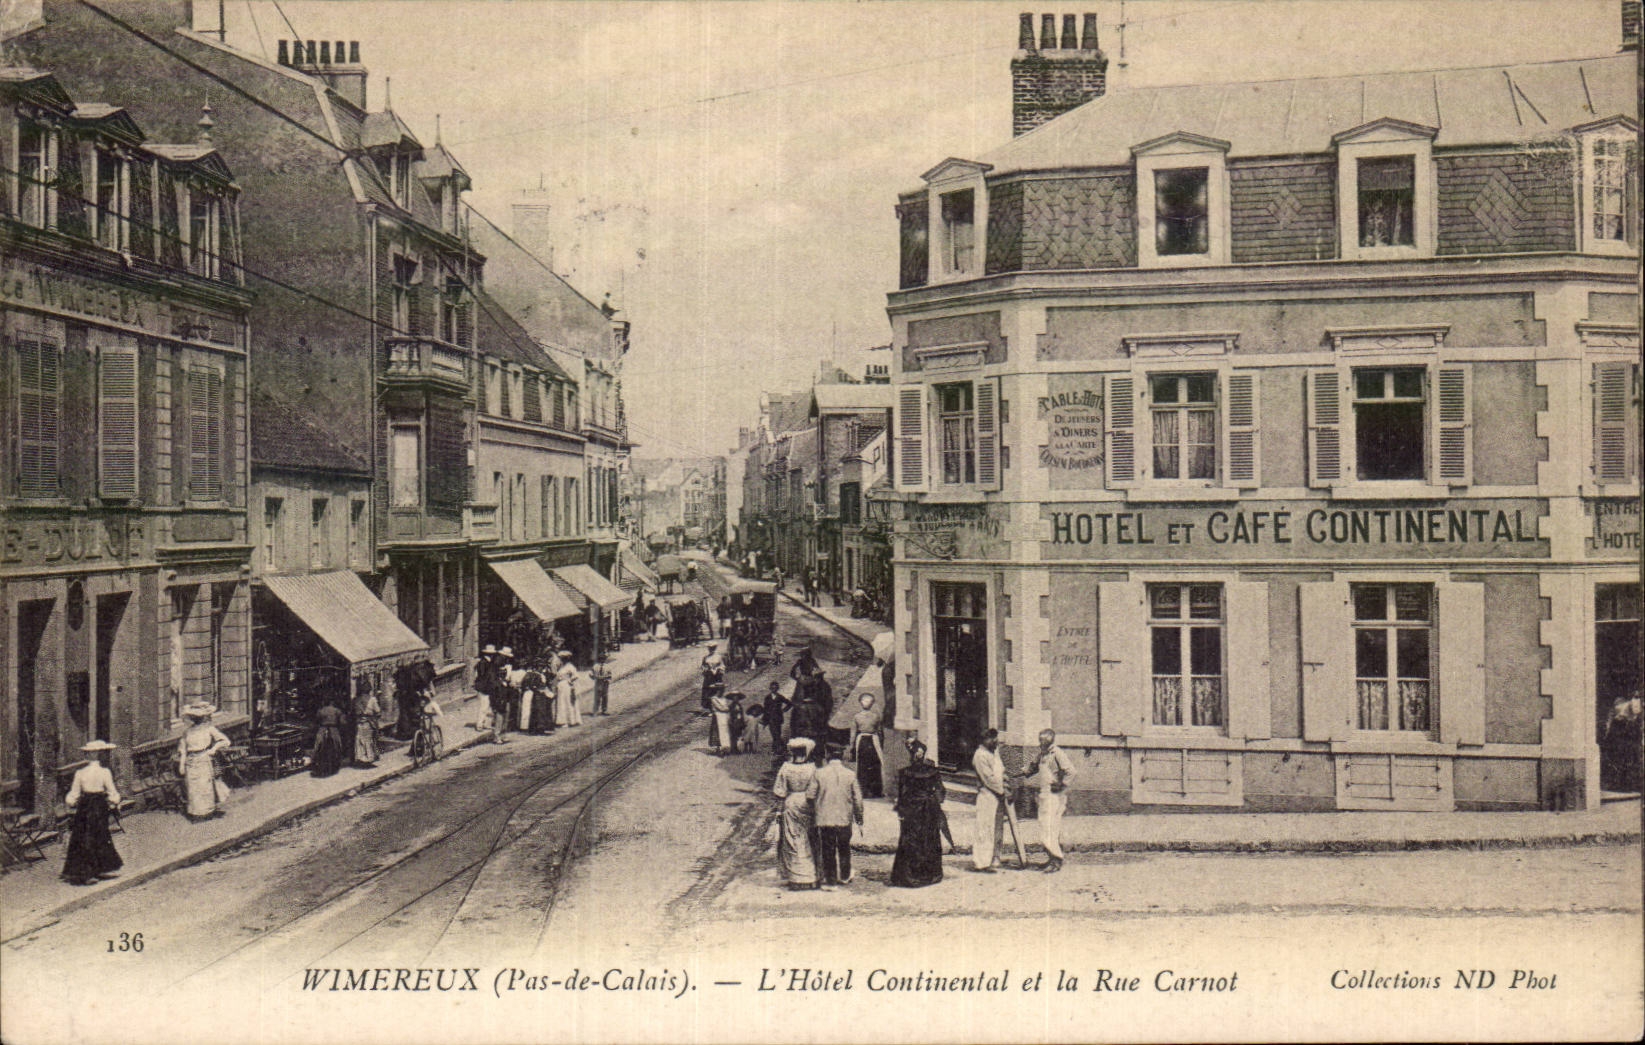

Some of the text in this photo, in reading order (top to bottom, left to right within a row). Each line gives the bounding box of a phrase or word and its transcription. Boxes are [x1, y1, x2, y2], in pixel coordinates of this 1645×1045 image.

[1037, 391, 1079, 412] TABLE
[1052, 507, 1535, 545] HOTEL ET CAFÉ CONTINENTAL
